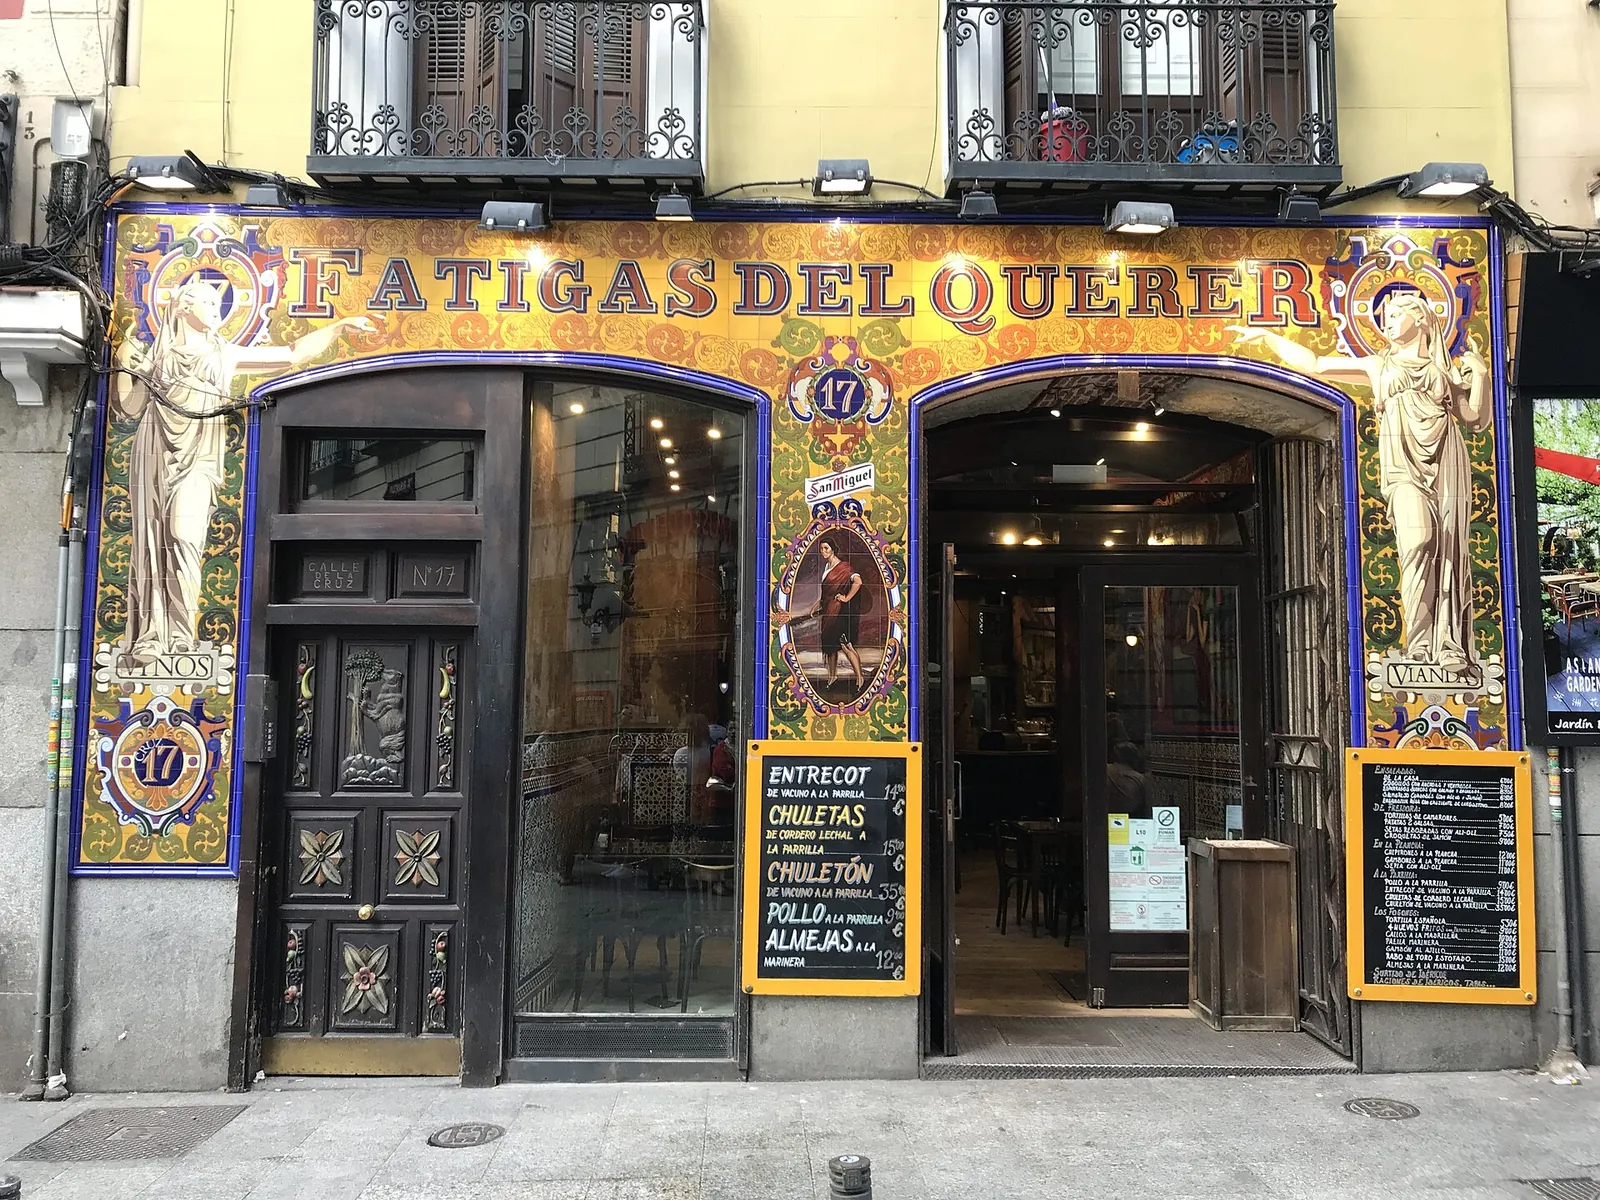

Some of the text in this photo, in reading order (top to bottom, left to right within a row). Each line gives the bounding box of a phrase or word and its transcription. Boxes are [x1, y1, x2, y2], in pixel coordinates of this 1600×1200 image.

[287, 247, 716, 319] FATIGAS
[732, 261, 915, 317] DEL
[928, 258, 1321, 335] QUERER
[820, 377, 857, 413] 17
[309, 562, 359, 572] CALLE
[337, 572, 353, 580] LA
[313, 580, 353, 589] CRUZ
[1555, 718, 1593, 728] Jardín
[135, 738, 164, 762] CRUZ
[142, 745, 178, 783] 17
[769, 766, 872, 785] ENTRECOT
[767, 788, 864, 799] DE VACUNO A LA PARRILLA
[769, 804, 865, 827] CHULETAS
[766, 830, 866, 840] DE CORDERO LECHAL A
[767, 844, 778, 854] LA
[783, 844, 824, 855] PARRILLA
[767, 855, 874, 884] CHULETÓN
[766, 887, 872, 899] DE VACUNO A LA PARRILLA
[767, 903, 883, 924] POLLO A LA PARRILLA
[765, 929, 875, 953] ALMEJAS A LA
[764, 957, 805, 968] MARINERA
